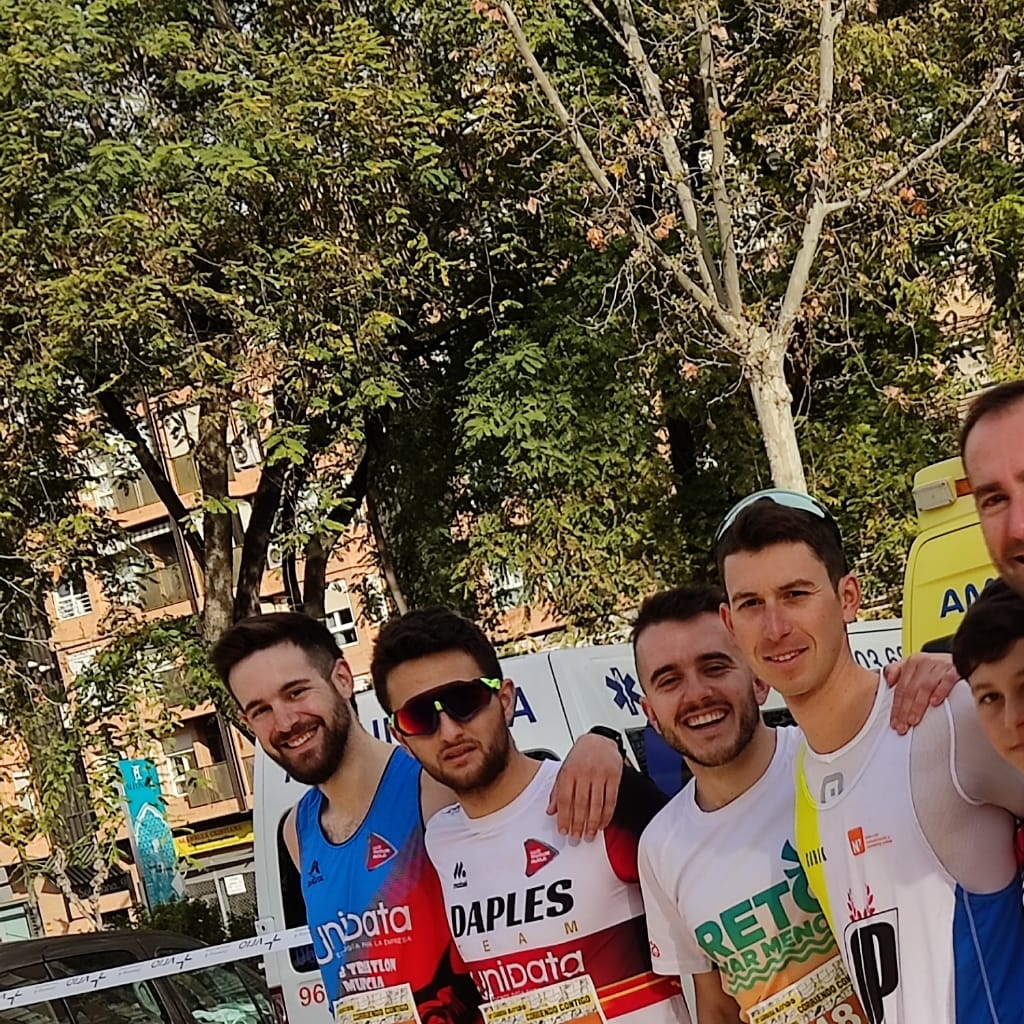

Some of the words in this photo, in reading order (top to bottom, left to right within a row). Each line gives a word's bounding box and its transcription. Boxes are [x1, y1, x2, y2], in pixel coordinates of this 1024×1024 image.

[450, 879, 574, 938] DAPLES
[761, 914, 829, 958] MENO
[299, 983, 326, 1007] 96
[559, 995, 591, 1011] CONTIGO
